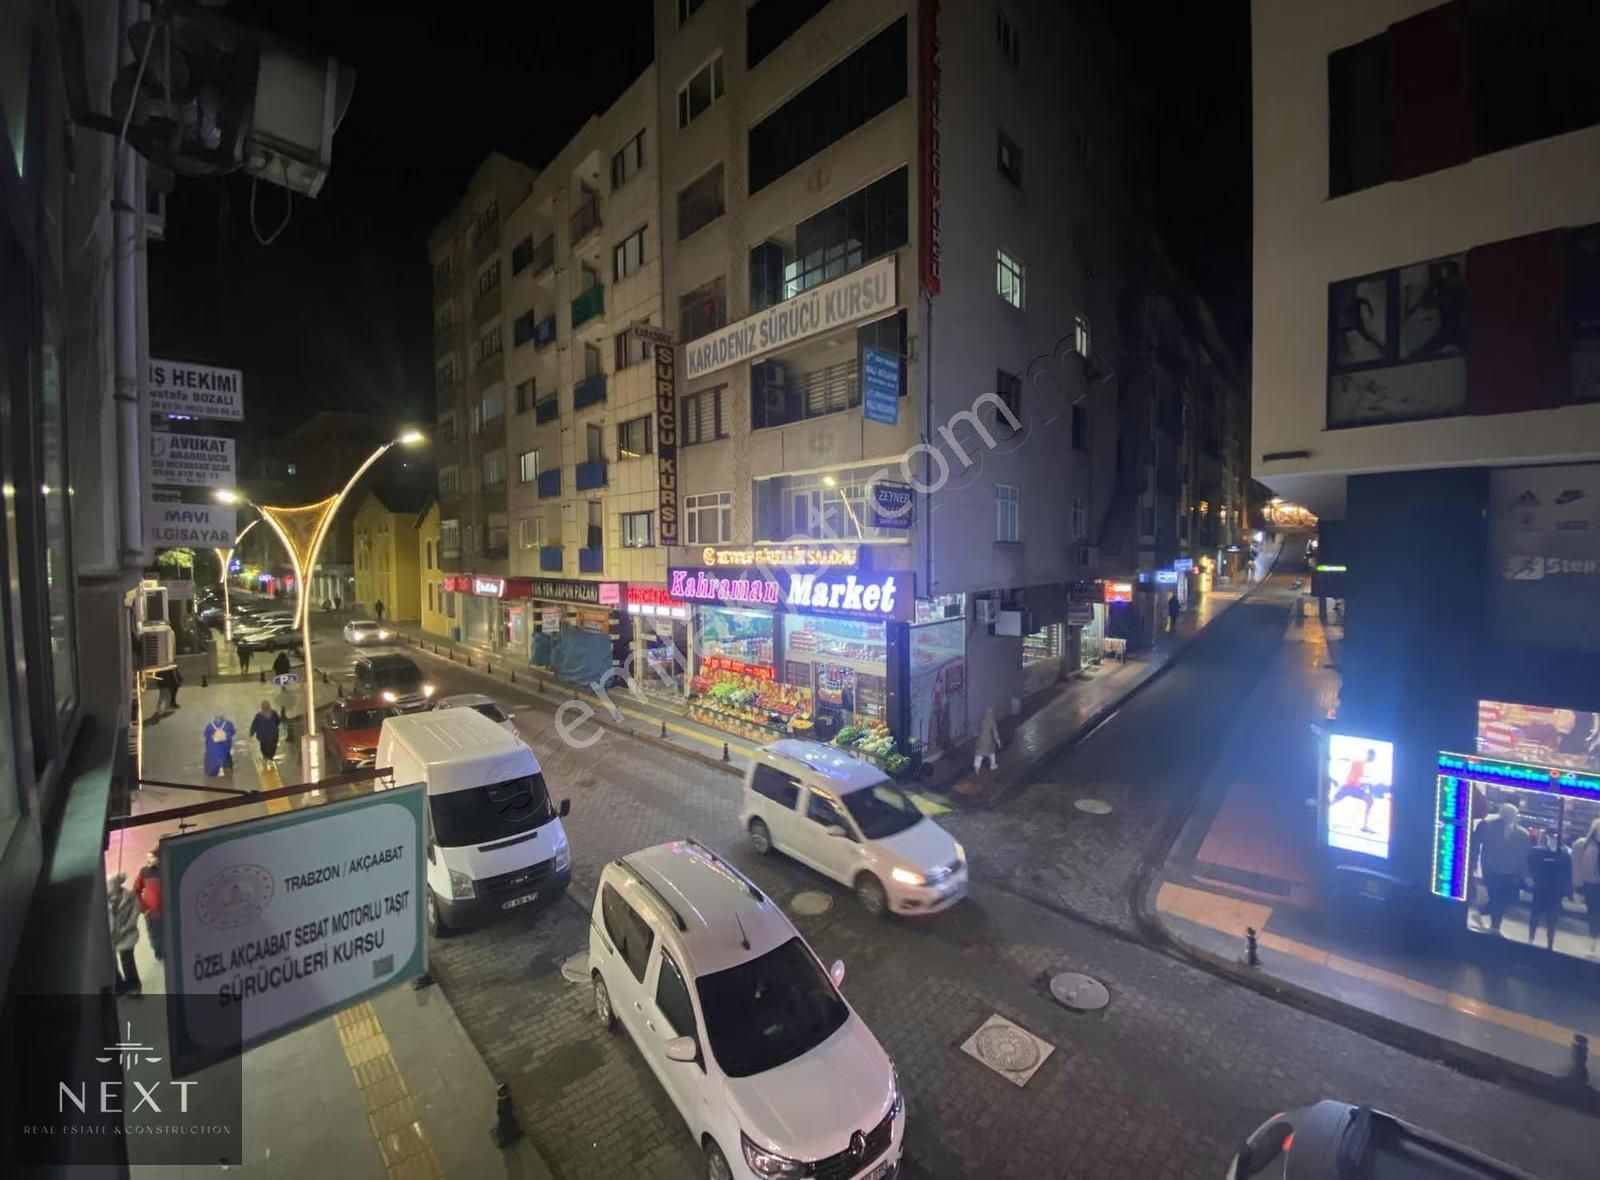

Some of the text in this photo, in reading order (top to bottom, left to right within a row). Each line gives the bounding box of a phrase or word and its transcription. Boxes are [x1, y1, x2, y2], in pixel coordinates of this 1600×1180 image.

[688, 271, 888, 374] KARADENİZ SÜRÜCÜ KURSU
[172, 369, 237, 393] HEKİMİ
[170, 436, 226, 452] AVUKAT
[660, 458, 676, 537] KURSU
[671, 570, 778, 603] Kahraman
[787, 573, 896, 612] Market
[284, 864, 340, 892] TRABZON
[349, 846, 404, 874] AKÇAABAT
[193, 891, 409, 981] ÖZEL AKÇAABAT SEBAT MOTORLU TAŞIT
[218, 928, 385, 1007] SÜRÜCÜLERİ KURSU
